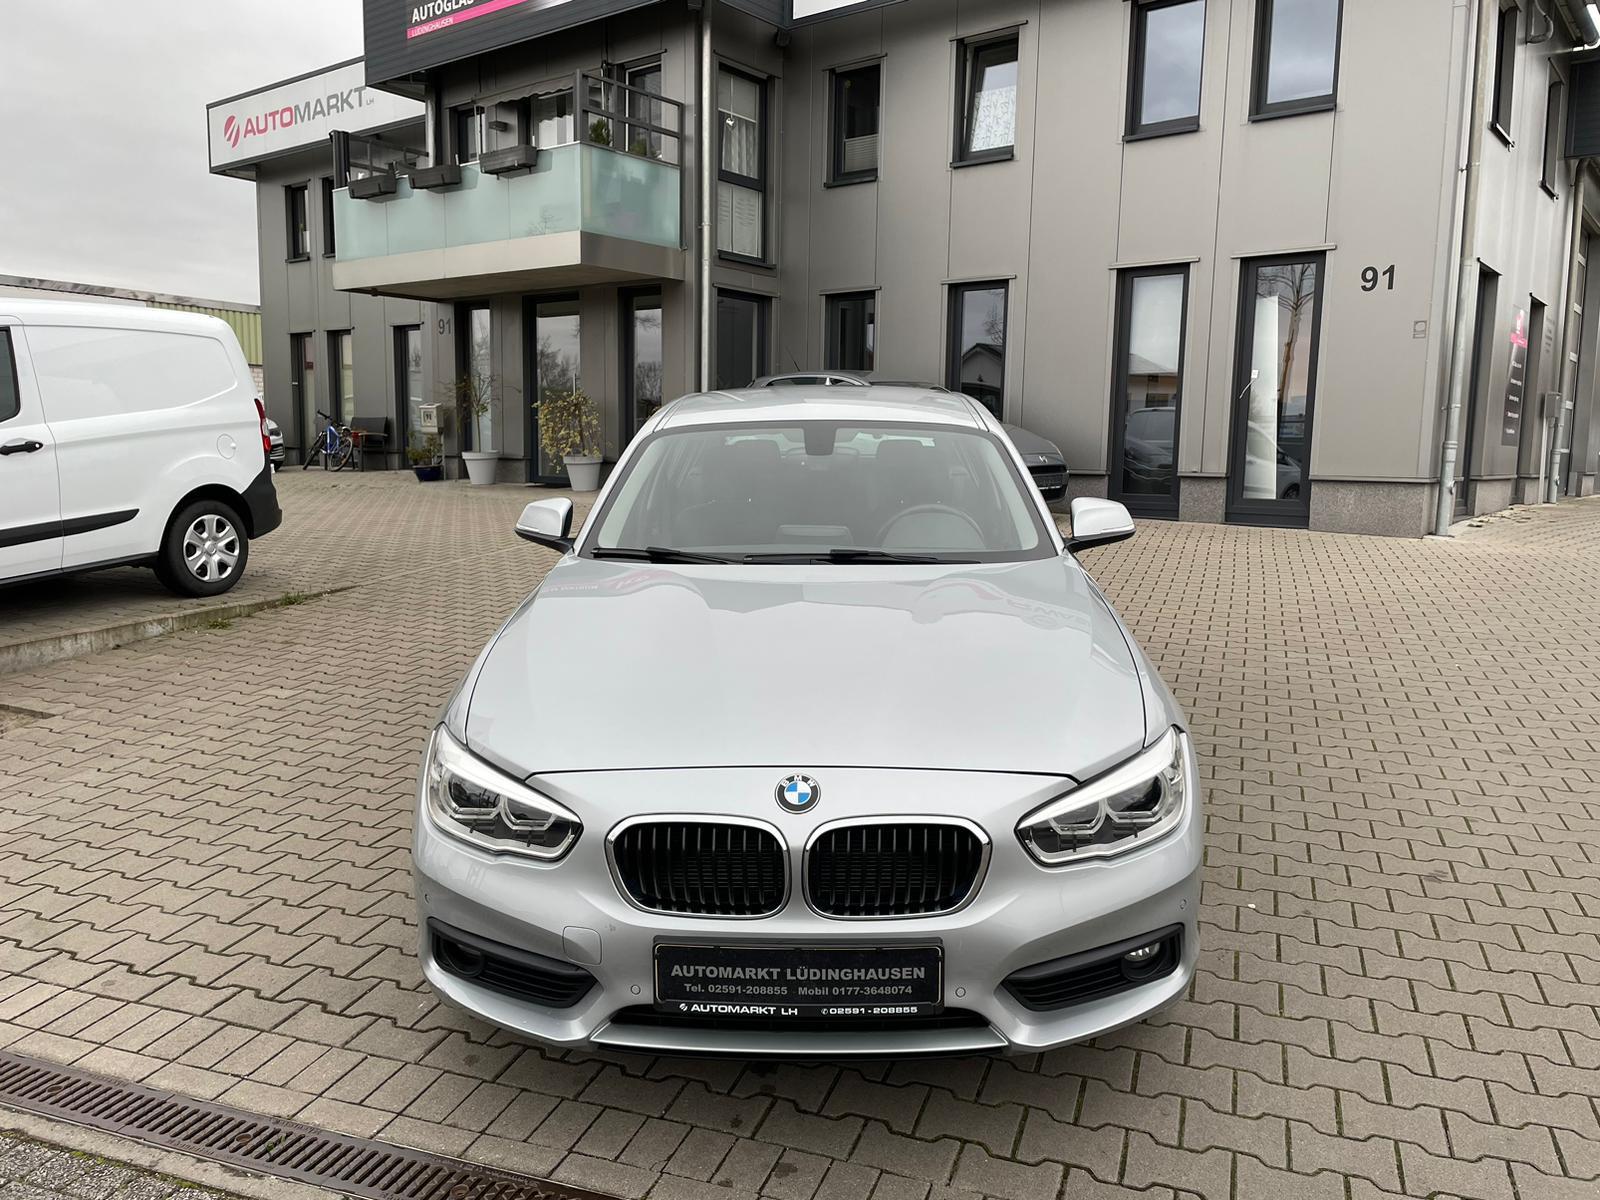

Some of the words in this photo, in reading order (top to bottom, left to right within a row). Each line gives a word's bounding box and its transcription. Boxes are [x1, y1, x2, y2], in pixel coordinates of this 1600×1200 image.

[243, 86, 366, 138] AUTOMARKT
[1361, 264, 1395, 292] 91
[438, 318, 451, 335] 91
[670, 964, 780, 980] AUTOMARKT
[786, 966, 926, 981] LÜDINGHAUSEN
[684, 983, 705, 993] Tel.
[708, 984, 788, 995] 02591-208855
[798, 986, 829, 996] Mobil
[832, 985, 913, 995] 0177-3648074
[690, 1003, 776, 1015] AUTOMARKT
[781, 1008, 798, 1016] LH
